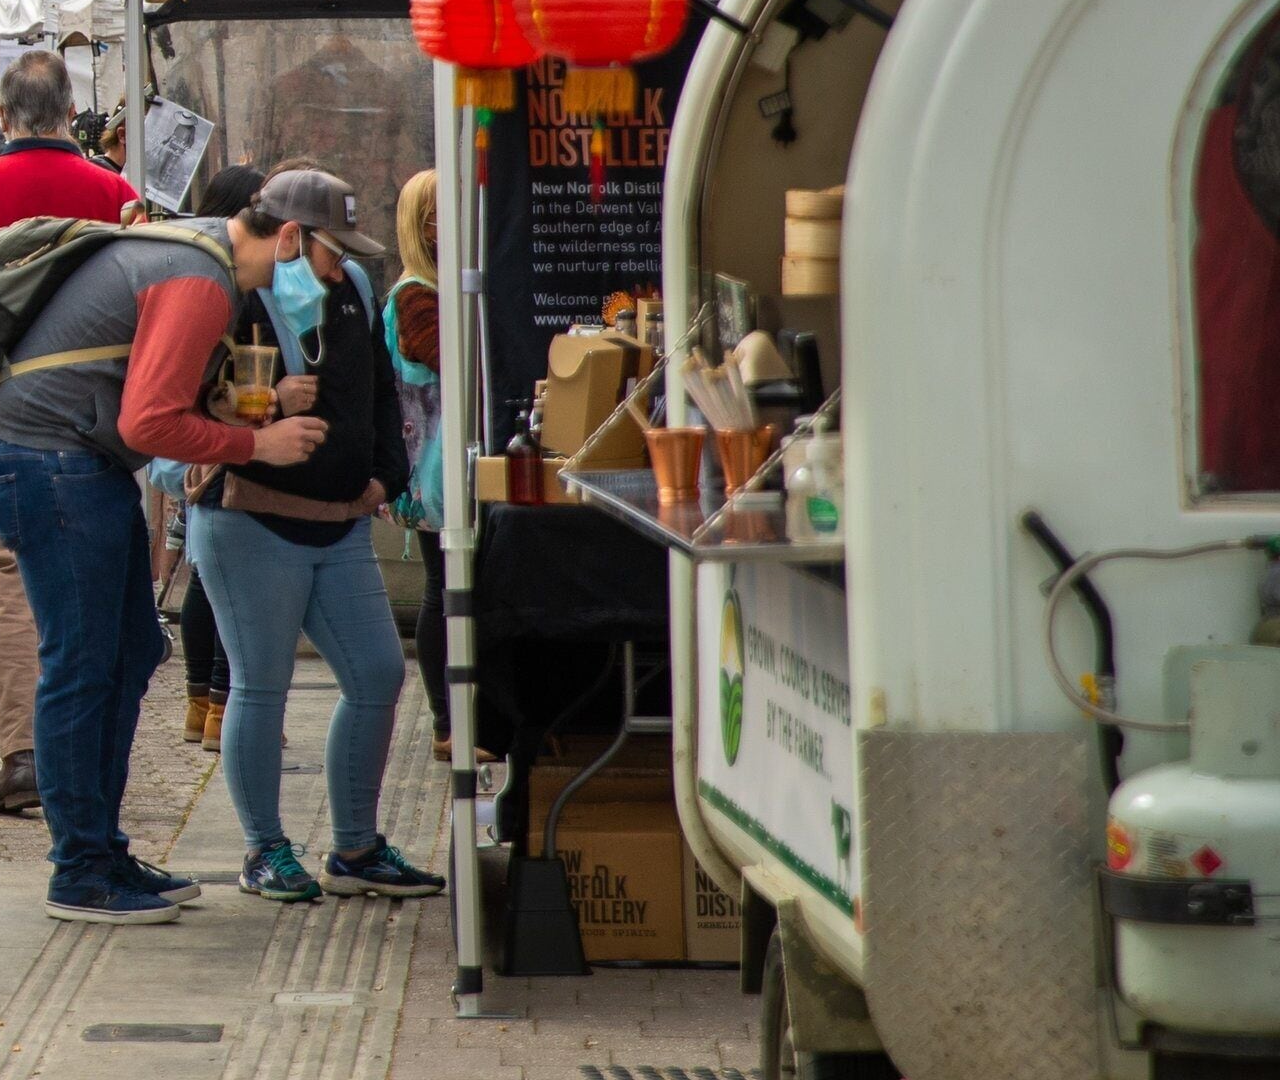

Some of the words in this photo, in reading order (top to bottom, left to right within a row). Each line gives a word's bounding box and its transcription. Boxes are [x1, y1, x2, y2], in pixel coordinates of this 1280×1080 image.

[532, 182, 562, 194] New
[567, 181, 620, 194] Norolk
[532, 201, 544, 214] in
[549, 201, 571, 214] the
[576, 200, 633, 214] Derwent
[533, 220, 595, 234] southern
[600, 220, 633, 236] edge
[637, 220, 650, 233] of
[533, 240, 555, 253] the
[559, 240, 636, 253] wilderness
[533, 262, 553, 273] we
[557, 260, 610, 273] nurture
[534, 293, 598, 306] Welcome
